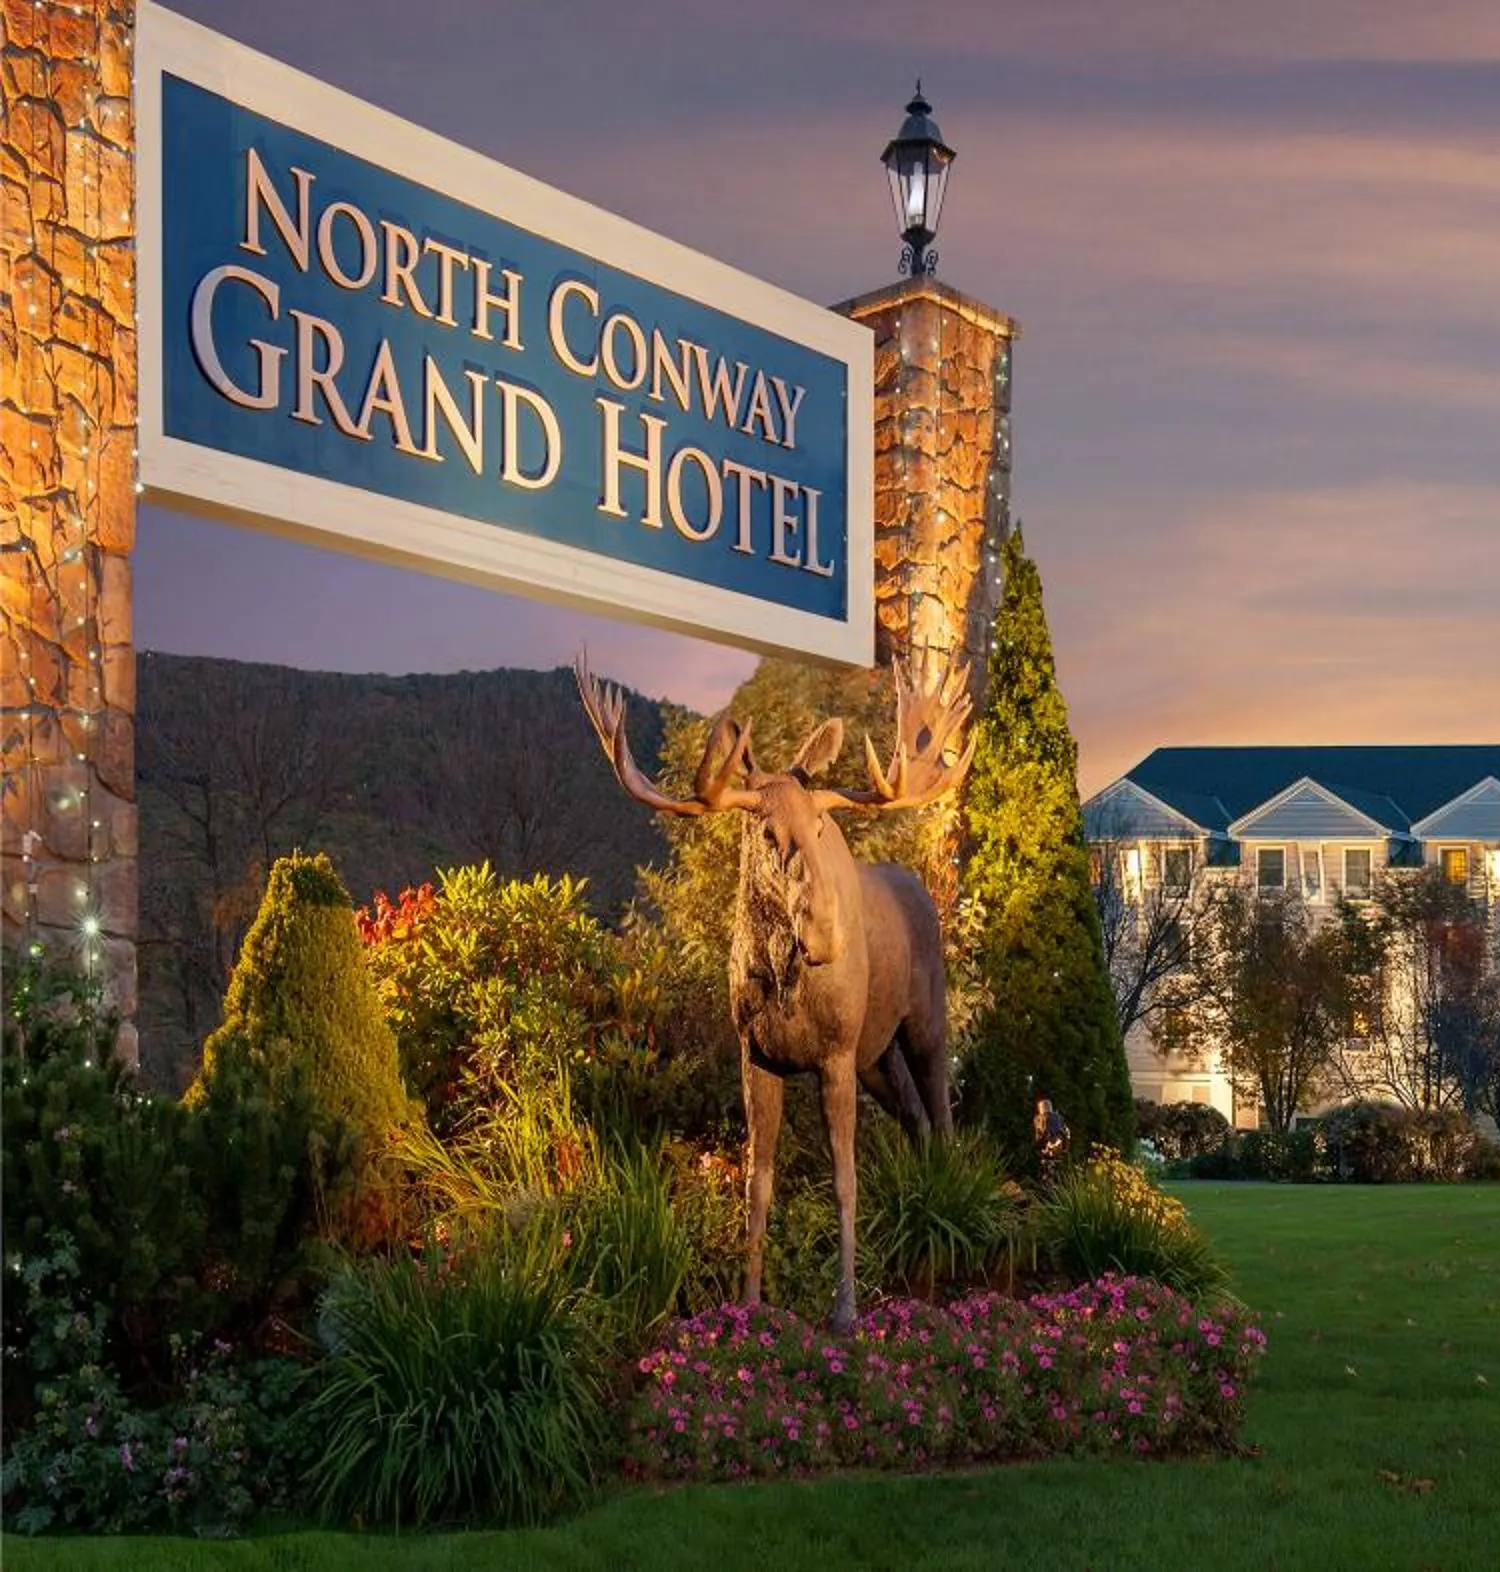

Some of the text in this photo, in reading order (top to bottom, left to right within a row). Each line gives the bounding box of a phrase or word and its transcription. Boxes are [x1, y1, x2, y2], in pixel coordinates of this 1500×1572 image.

[188, 264, 836, 578] GRAND HOTEL
[238, 147, 807, 449] NORTH CONWAY
